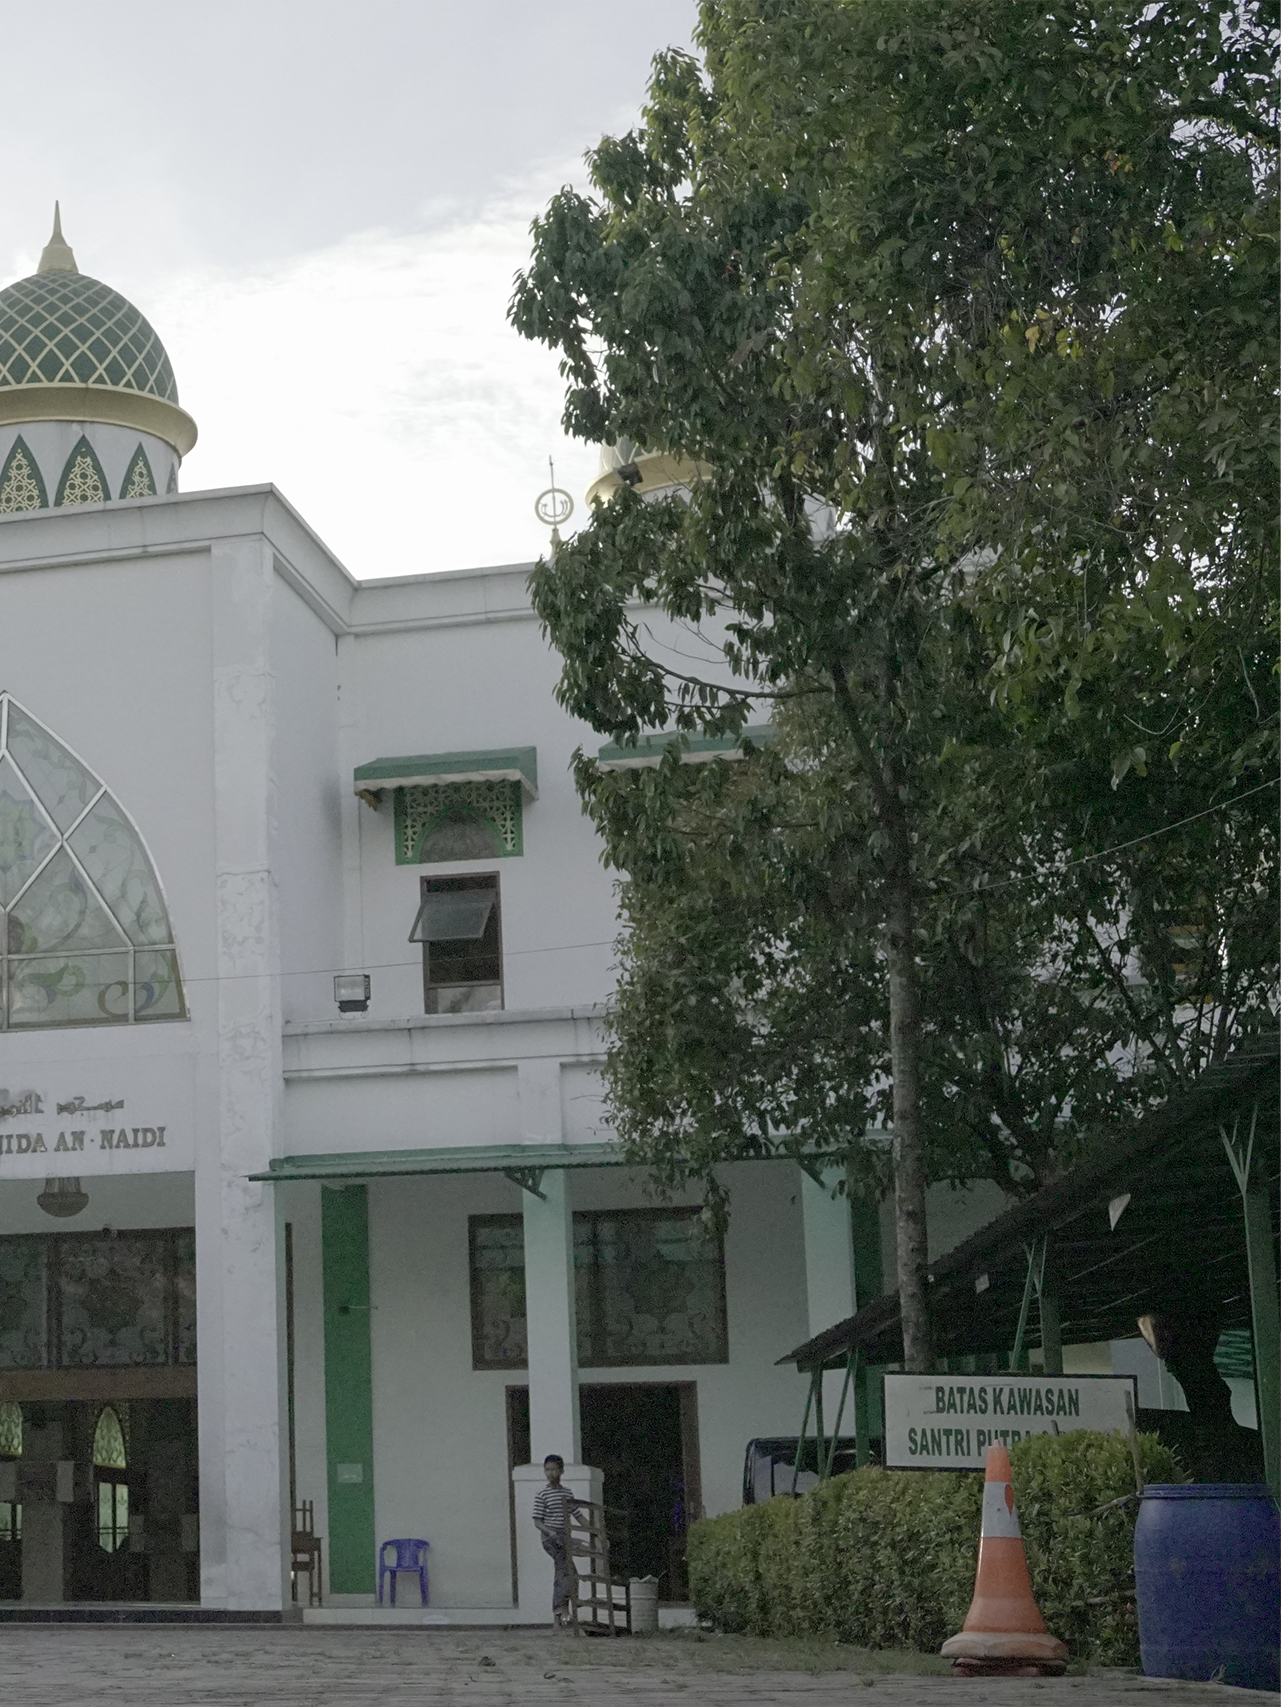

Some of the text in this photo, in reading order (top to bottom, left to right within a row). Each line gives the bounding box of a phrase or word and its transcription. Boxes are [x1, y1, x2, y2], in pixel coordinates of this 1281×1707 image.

[935, 1386, 1080, 1417] BATAS KAWASAN
[907, 1427, 1032, 1457] SANTRI PUTR
